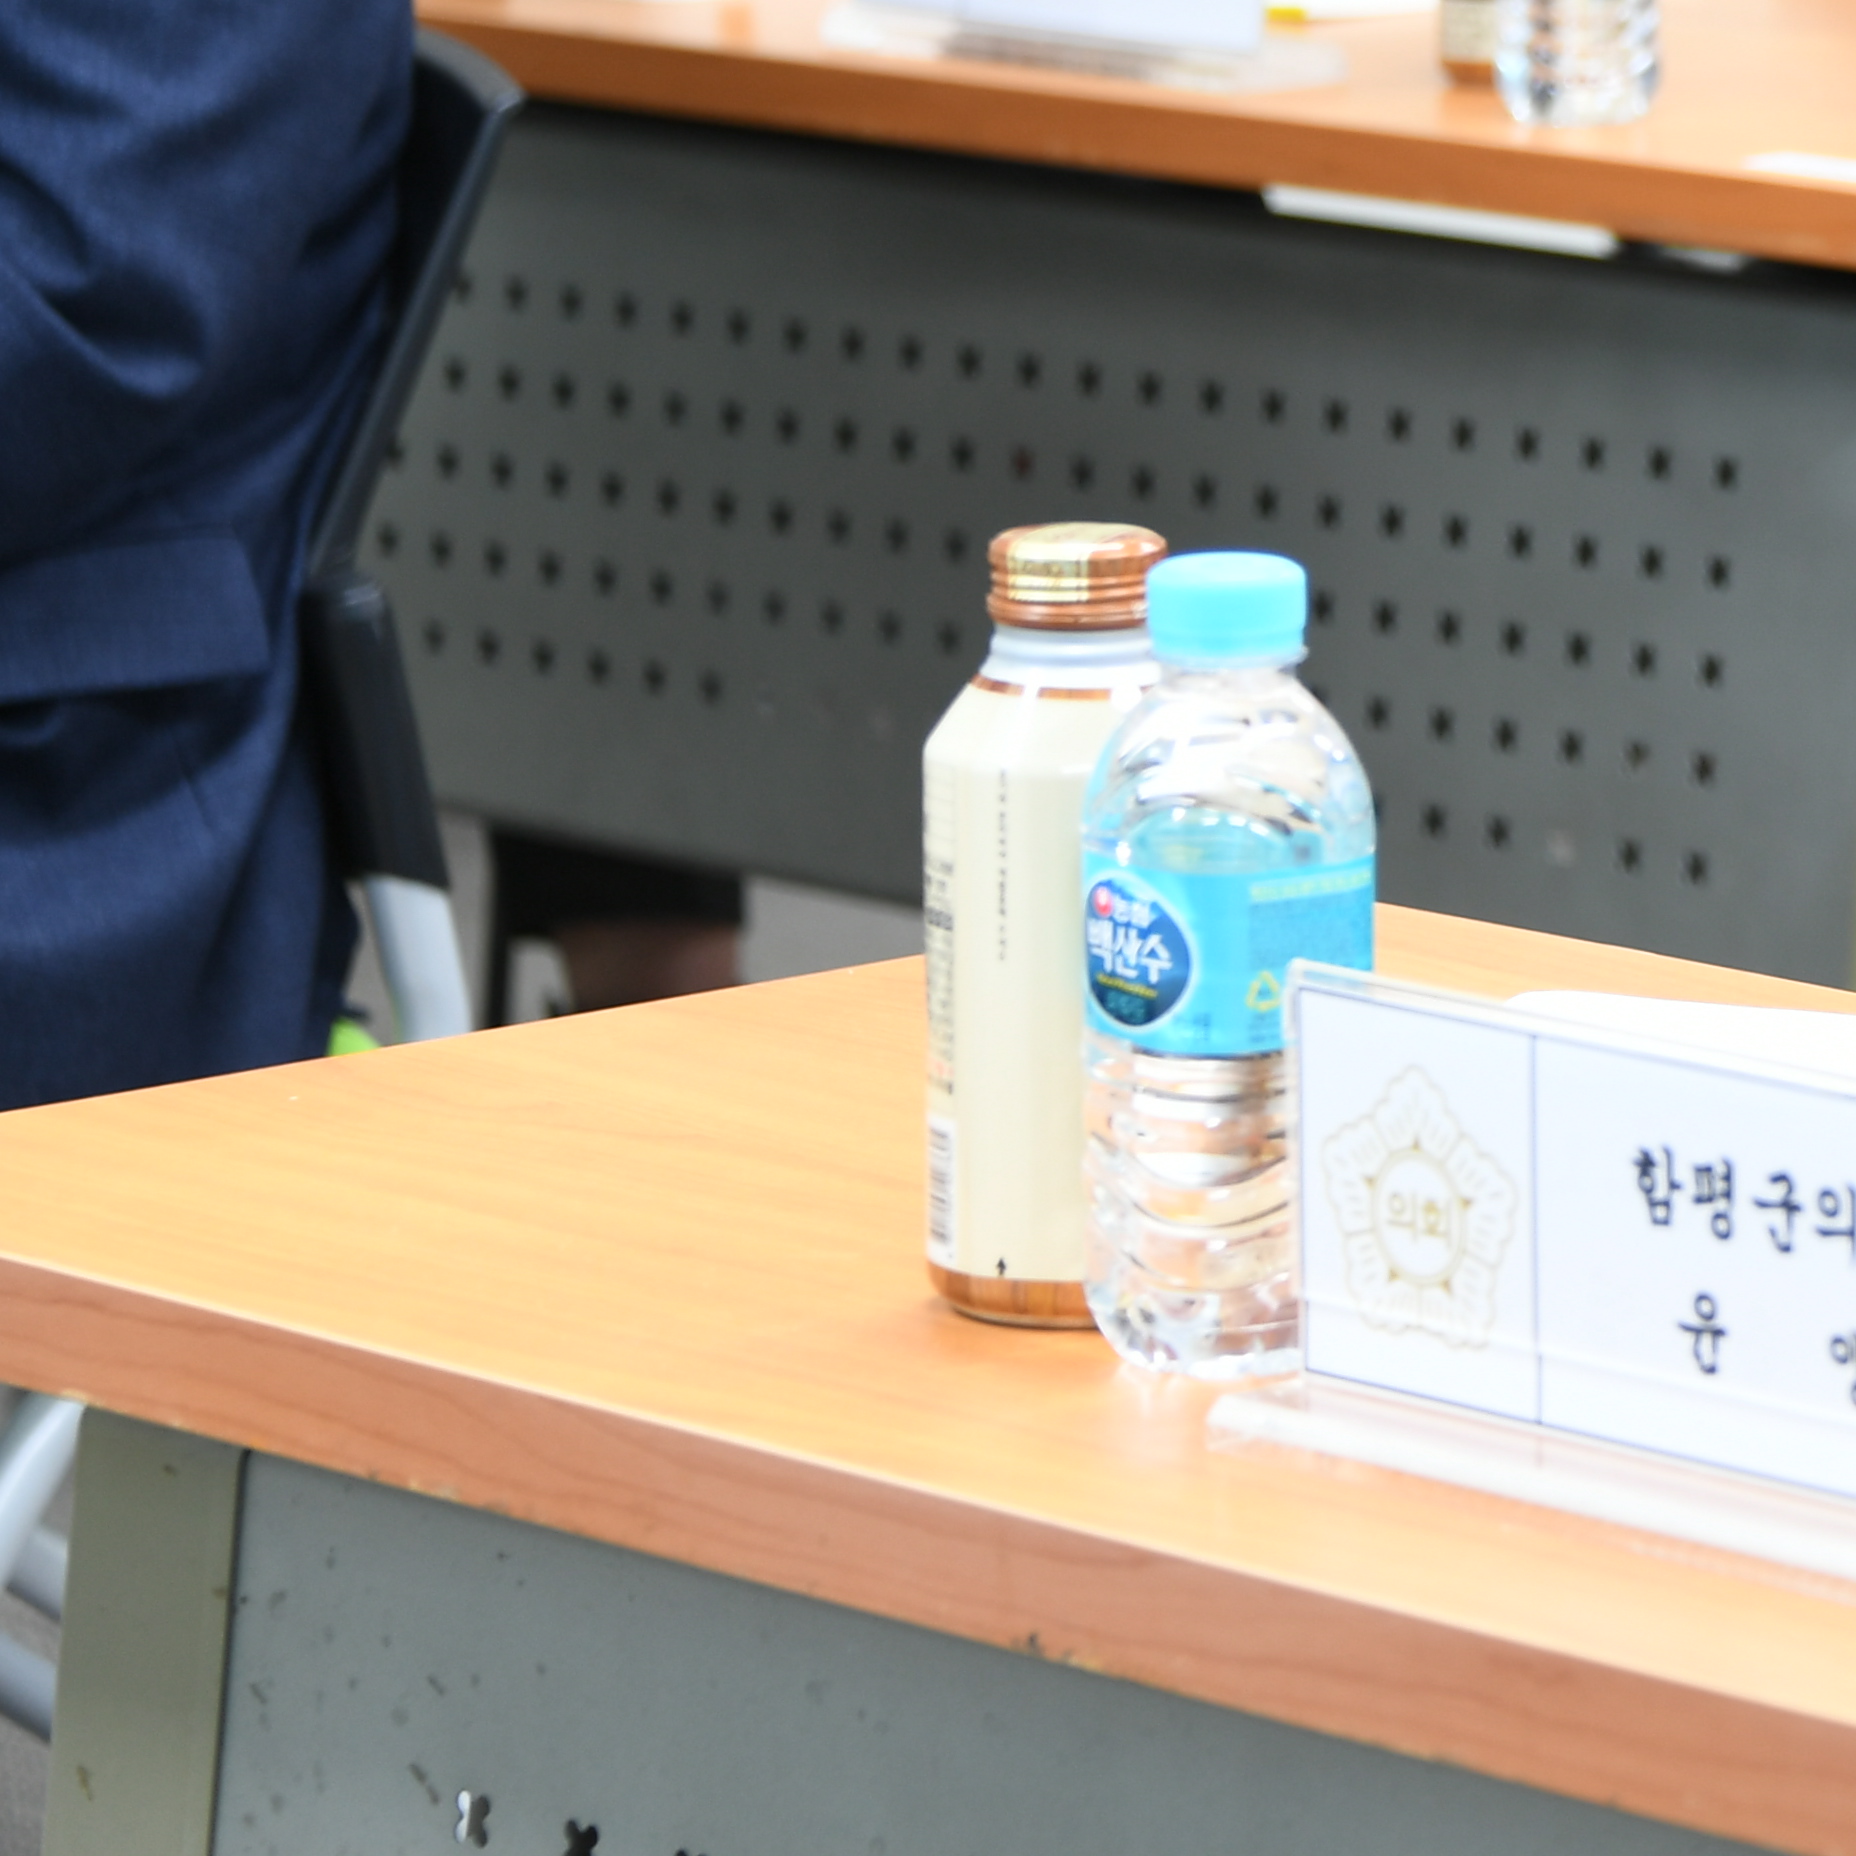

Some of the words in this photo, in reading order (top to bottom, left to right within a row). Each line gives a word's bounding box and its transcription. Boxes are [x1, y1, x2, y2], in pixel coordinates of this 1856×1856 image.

[1086, 917, 1173, 984] 백산수
[1386, 1190, 1450, 1249] 의회
[1677, 1291, 1728, 1376] 윤
